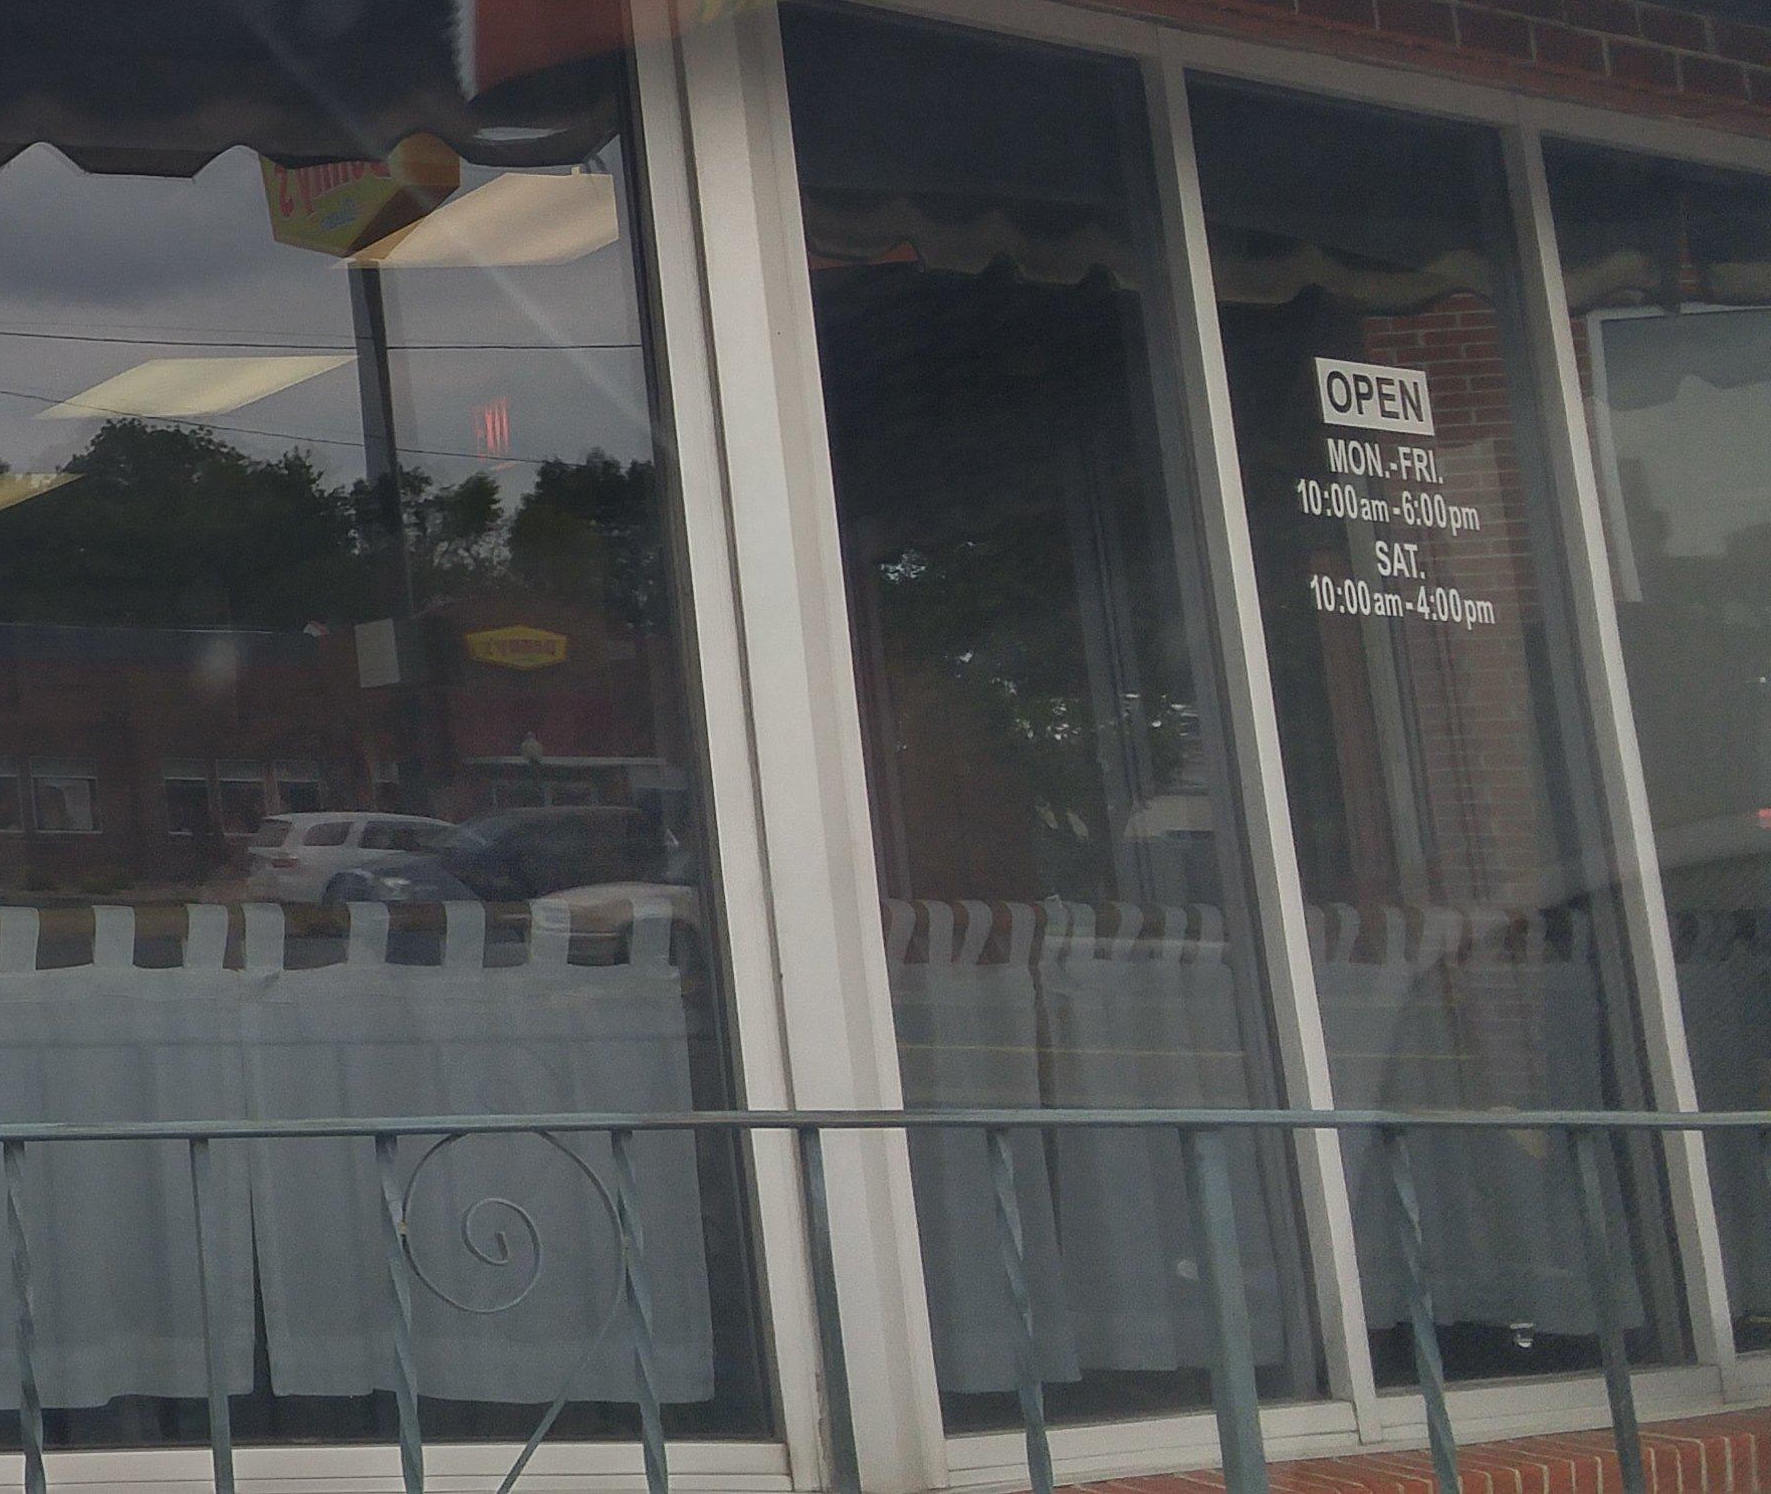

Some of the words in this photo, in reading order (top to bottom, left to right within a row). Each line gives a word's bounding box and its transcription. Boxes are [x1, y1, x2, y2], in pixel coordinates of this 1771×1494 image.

[1325, 369, 1426, 424] OPEN
[1326, 437, 1444, 485] MON.-FRI.
[1374, 540, 1427, 580] SAT.
